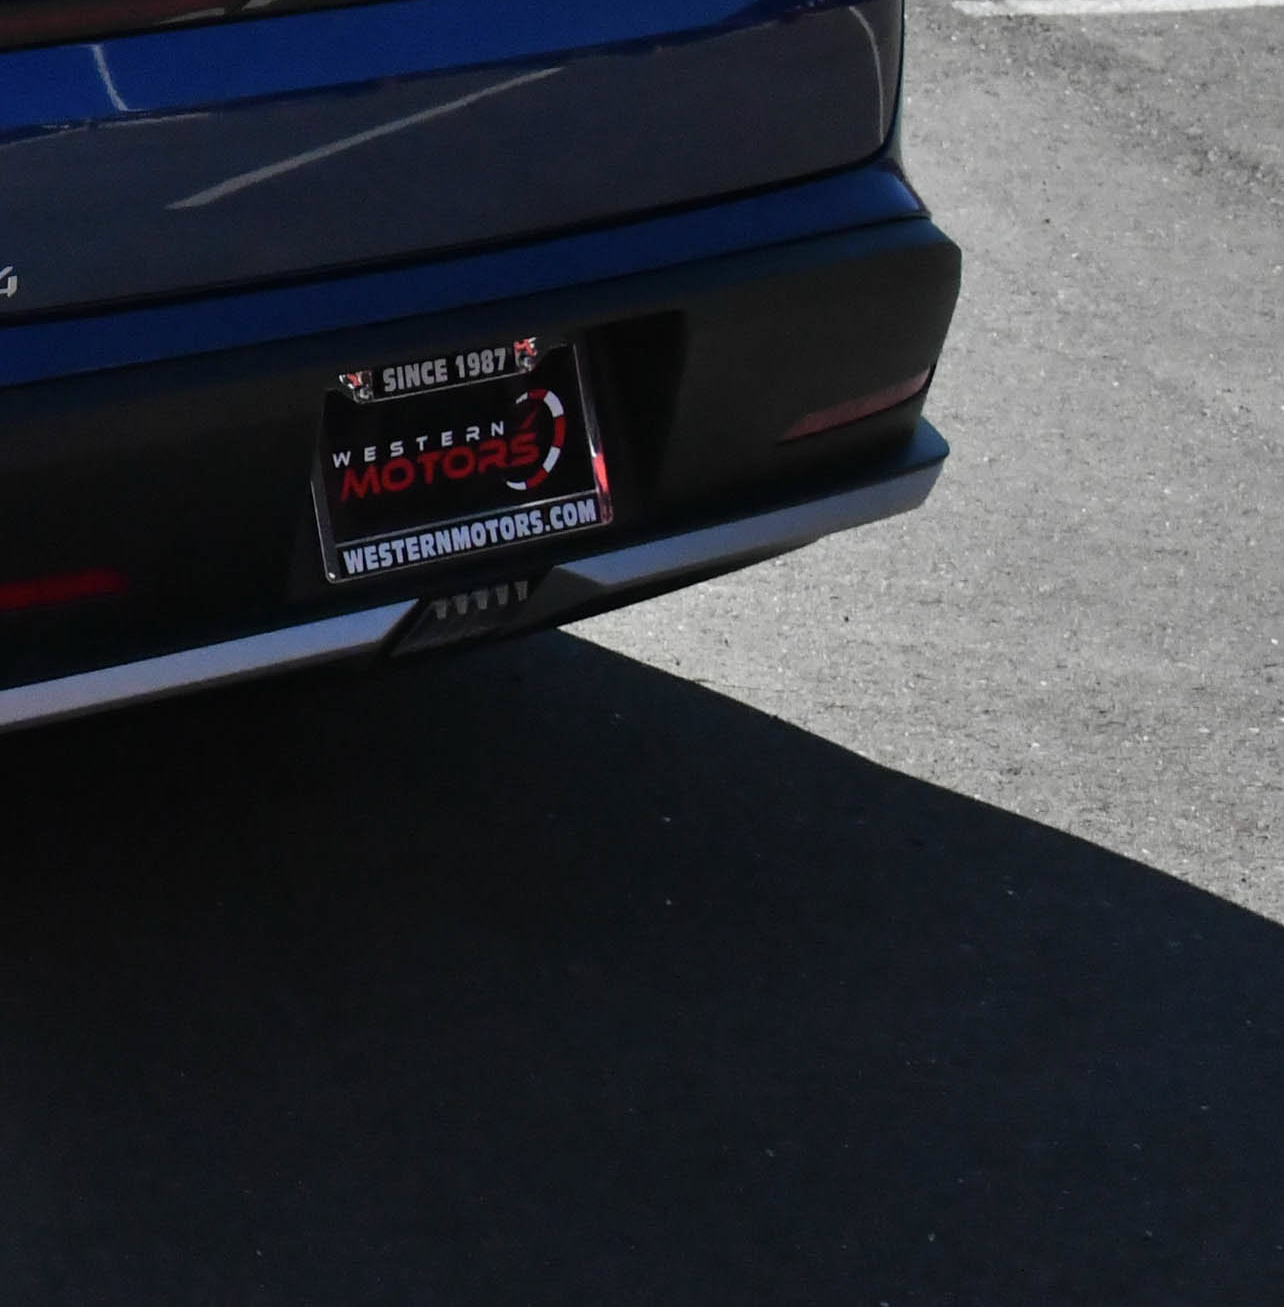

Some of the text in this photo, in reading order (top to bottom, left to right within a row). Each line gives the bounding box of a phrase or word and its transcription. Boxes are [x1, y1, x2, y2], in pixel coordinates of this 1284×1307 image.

[382, 348, 506, 392] SINCE 1987
[333, 421, 504, 469] WESTERN
[340, 430, 540, 502] MOTORS
[343, 498, 596, 575] WESTERNMOTORS.COM
